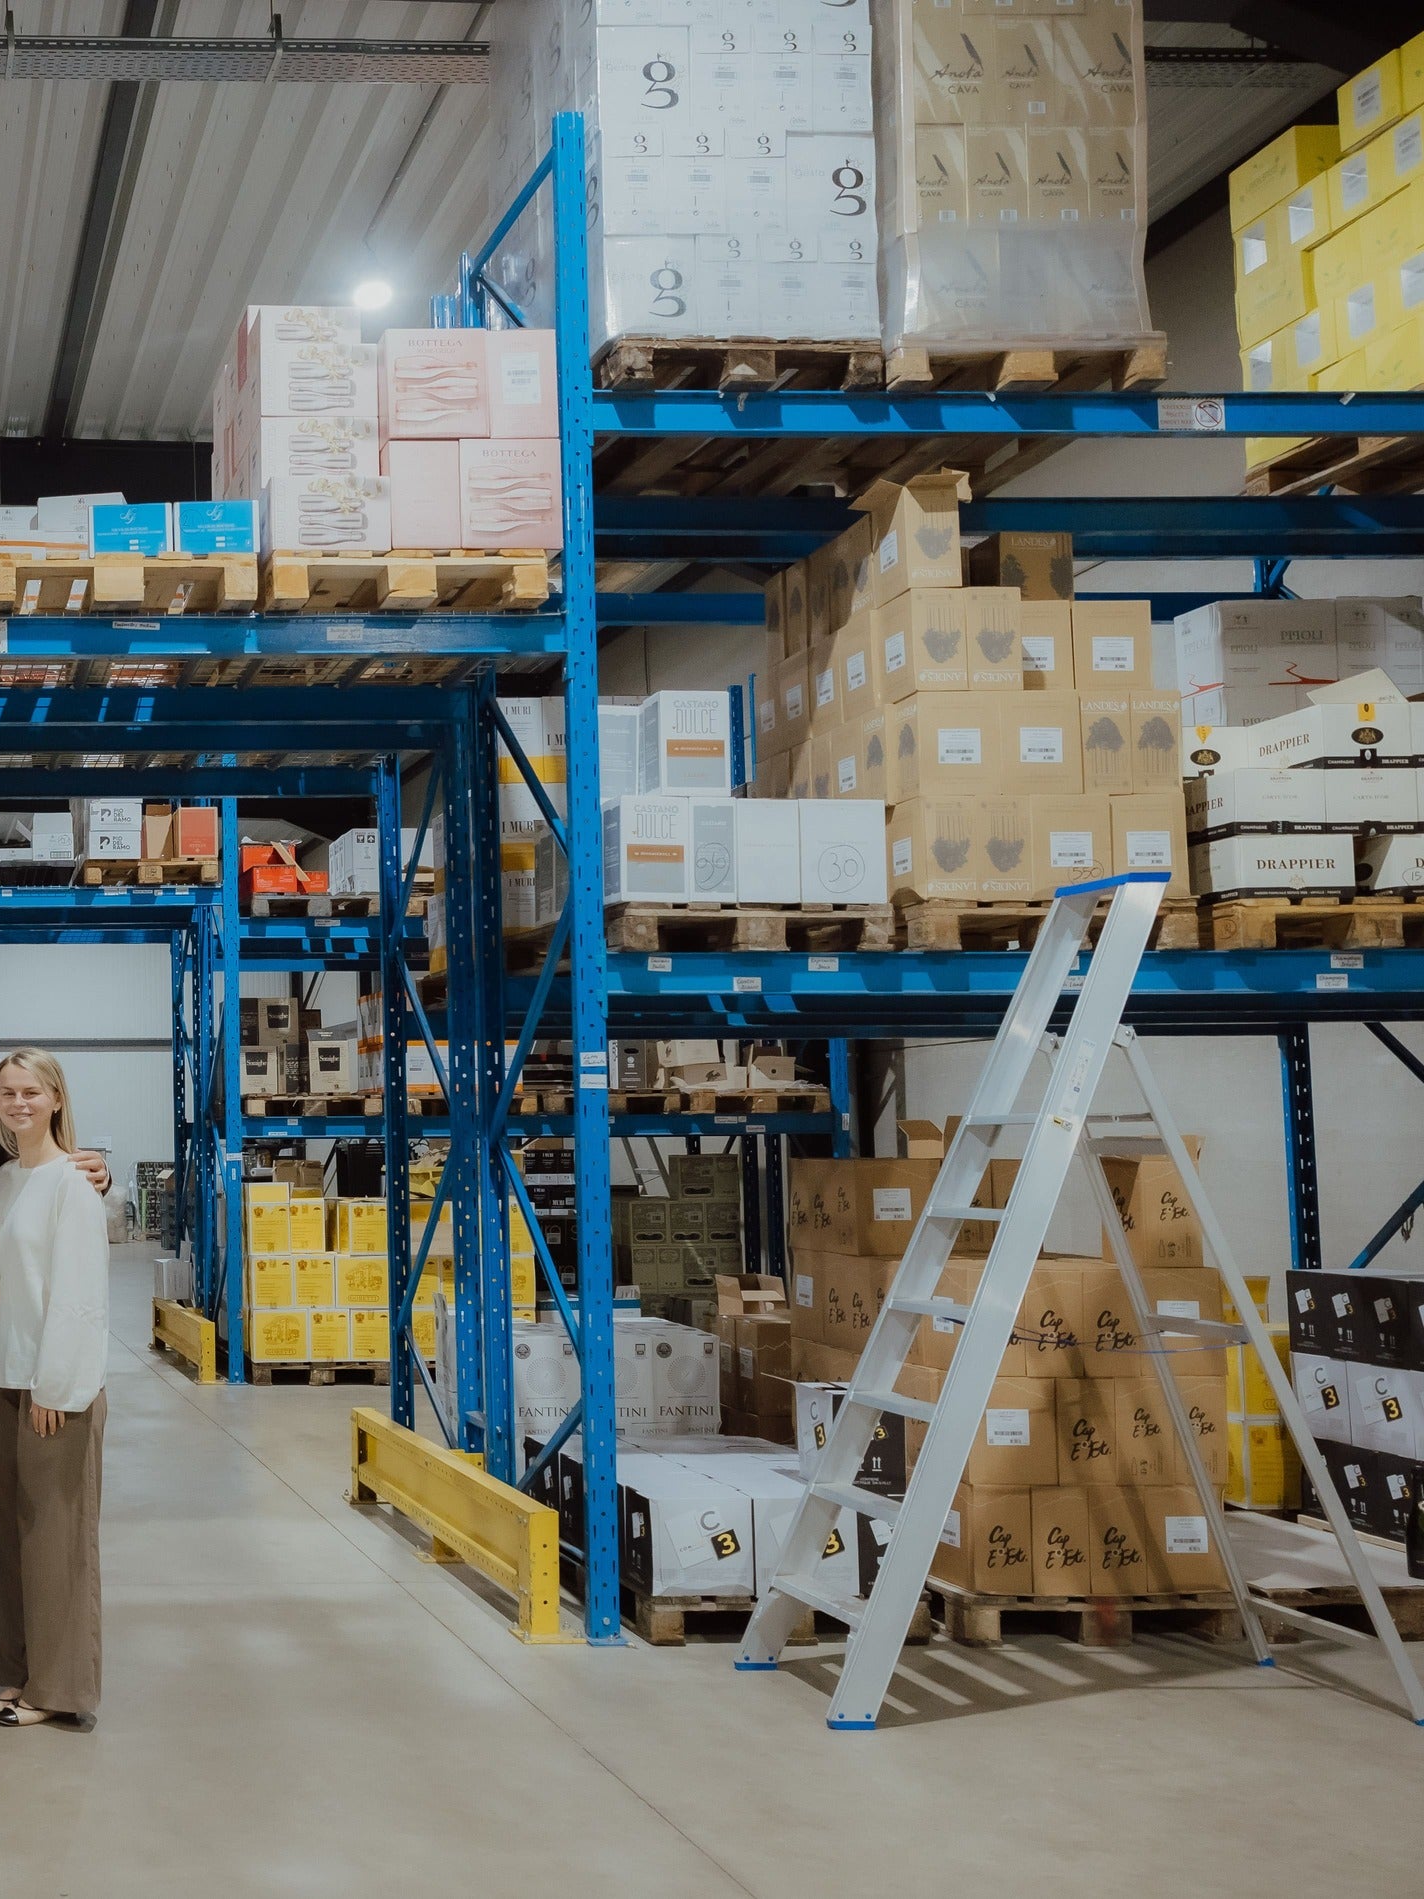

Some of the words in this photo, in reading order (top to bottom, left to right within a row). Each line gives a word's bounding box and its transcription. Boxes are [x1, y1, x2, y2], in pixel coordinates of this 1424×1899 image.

[721, 32, 736, 51] g
[783, 31, 797, 51] g
[843, 32, 856, 52] g
[930, 64, 984, 79] Anota
[641, 60, 679, 110] g
[948, 85, 979, 95] CAVA
[1101, 84, 1132, 94] CAVA
[633, 134, 648, 153] g
[696, 134, 710, 153] g
[829, 166, 867, 216] g
[649, 267, 687, 317] g
[408, 339, 463, 347] BOTTEGA
[482, 450, 536, 458] BOTTEGA
[1011, 537, 1047, 546] LANDES
[511, 706, 531, 715] MURI
[1082, 701, 1119, 711] LANDES
[1133, 701, 1171, 711] LANDES
[676, 709, 717, 733] DULCE
[1259, 733, 1310, 757] DRAPPIER
[510, 821, 535, 833] MUR
[636, 814, 676, 838] DULCE
[828, 852, 858, 883] 30
[1257, 859, 1336, 869] DRAPPIER
[1160, 1192, 1177, 1207] Cap
[1040, 1310, 1063, 1331] Cap
[1097, 1310, 1120, 1331] Cap
[1314, 1368, 1326, 1384] C
[1375, 1378, 1388, 1395] C
[1327, 1388, 1336, 1406] 3
[518, 1407, 568, 1417] FANTIN
[617, 1407, 647, 1417] TINI
[659, 1405, 714, 1416] FANTINI
[810, 1402, 818, 1420] C
[1135, 1408, 1149, 1424] Cap
[1387, 1400, 1399, 1418] 3
[816, 1426, 824, 1445] 3
[1072, 1419, 1095, 1441] Cap
[700, 1511, 719, 1531] C
[717, 1533, 735, 1555] 3
[989, 1525, 1012, 1547] Cap
[1048, 1527, 1070, 1547] Cap
[1104, 1527, 1126, 1548] Cap
